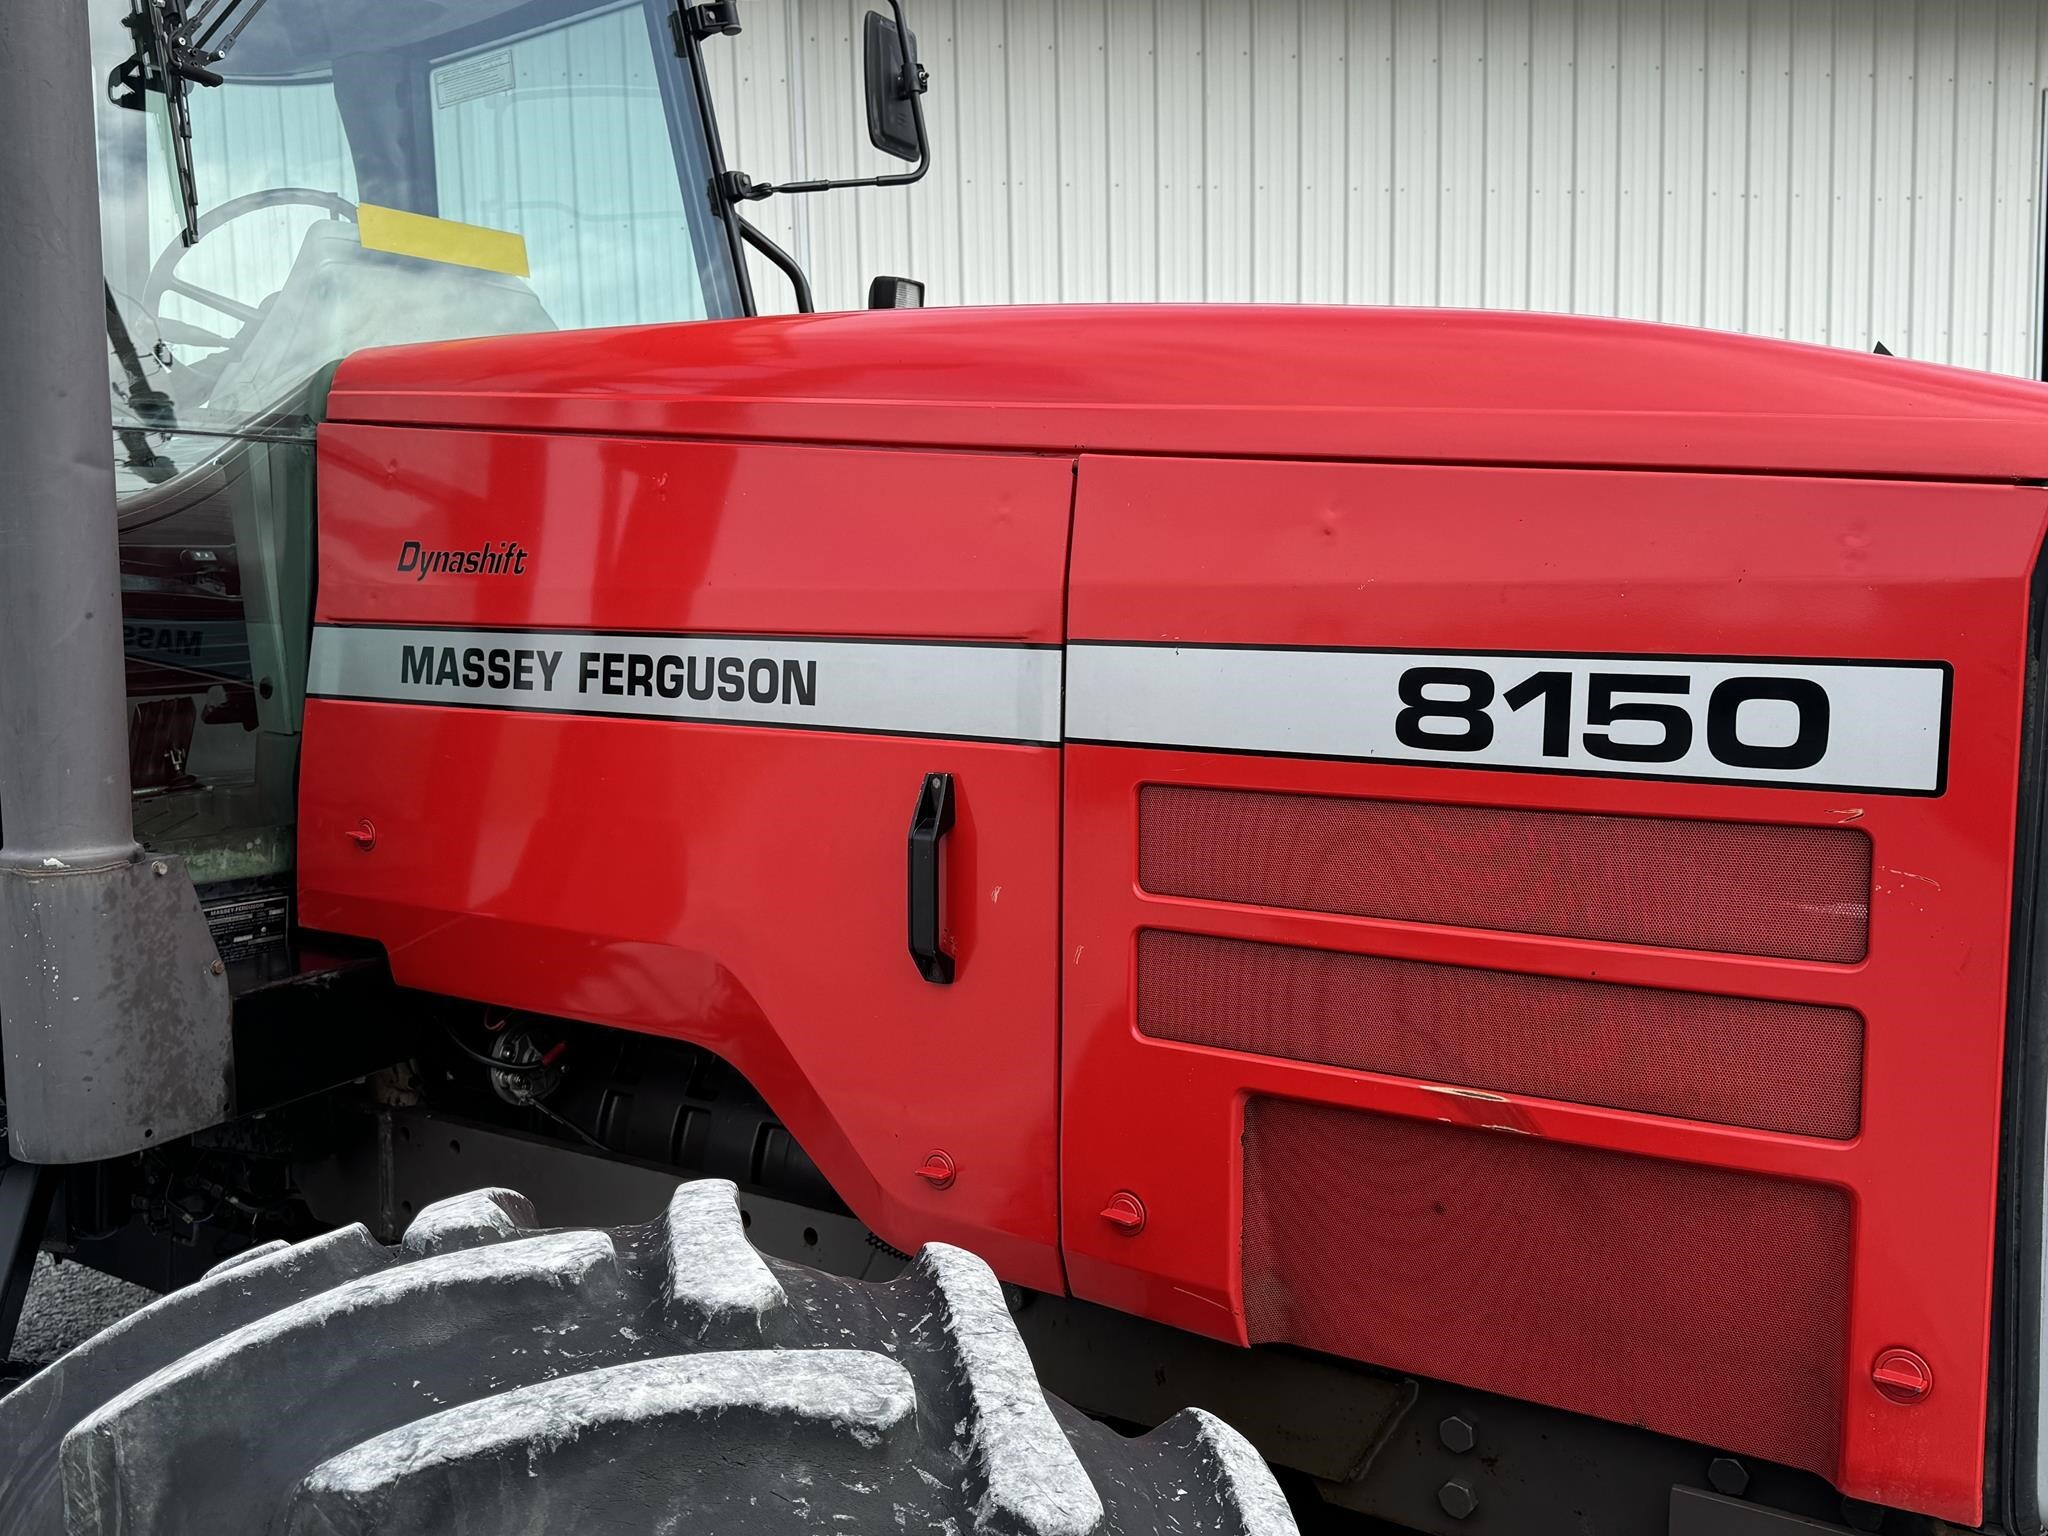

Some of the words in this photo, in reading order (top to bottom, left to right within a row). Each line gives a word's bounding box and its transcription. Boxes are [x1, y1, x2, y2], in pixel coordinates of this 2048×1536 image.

[397, 541, 527, 581] Dynashift
[401, 645, 562, 691] MASSEY
[579, 652, 817, 706] FERGUSON
[1395, 667, 1830, 770] 8150
